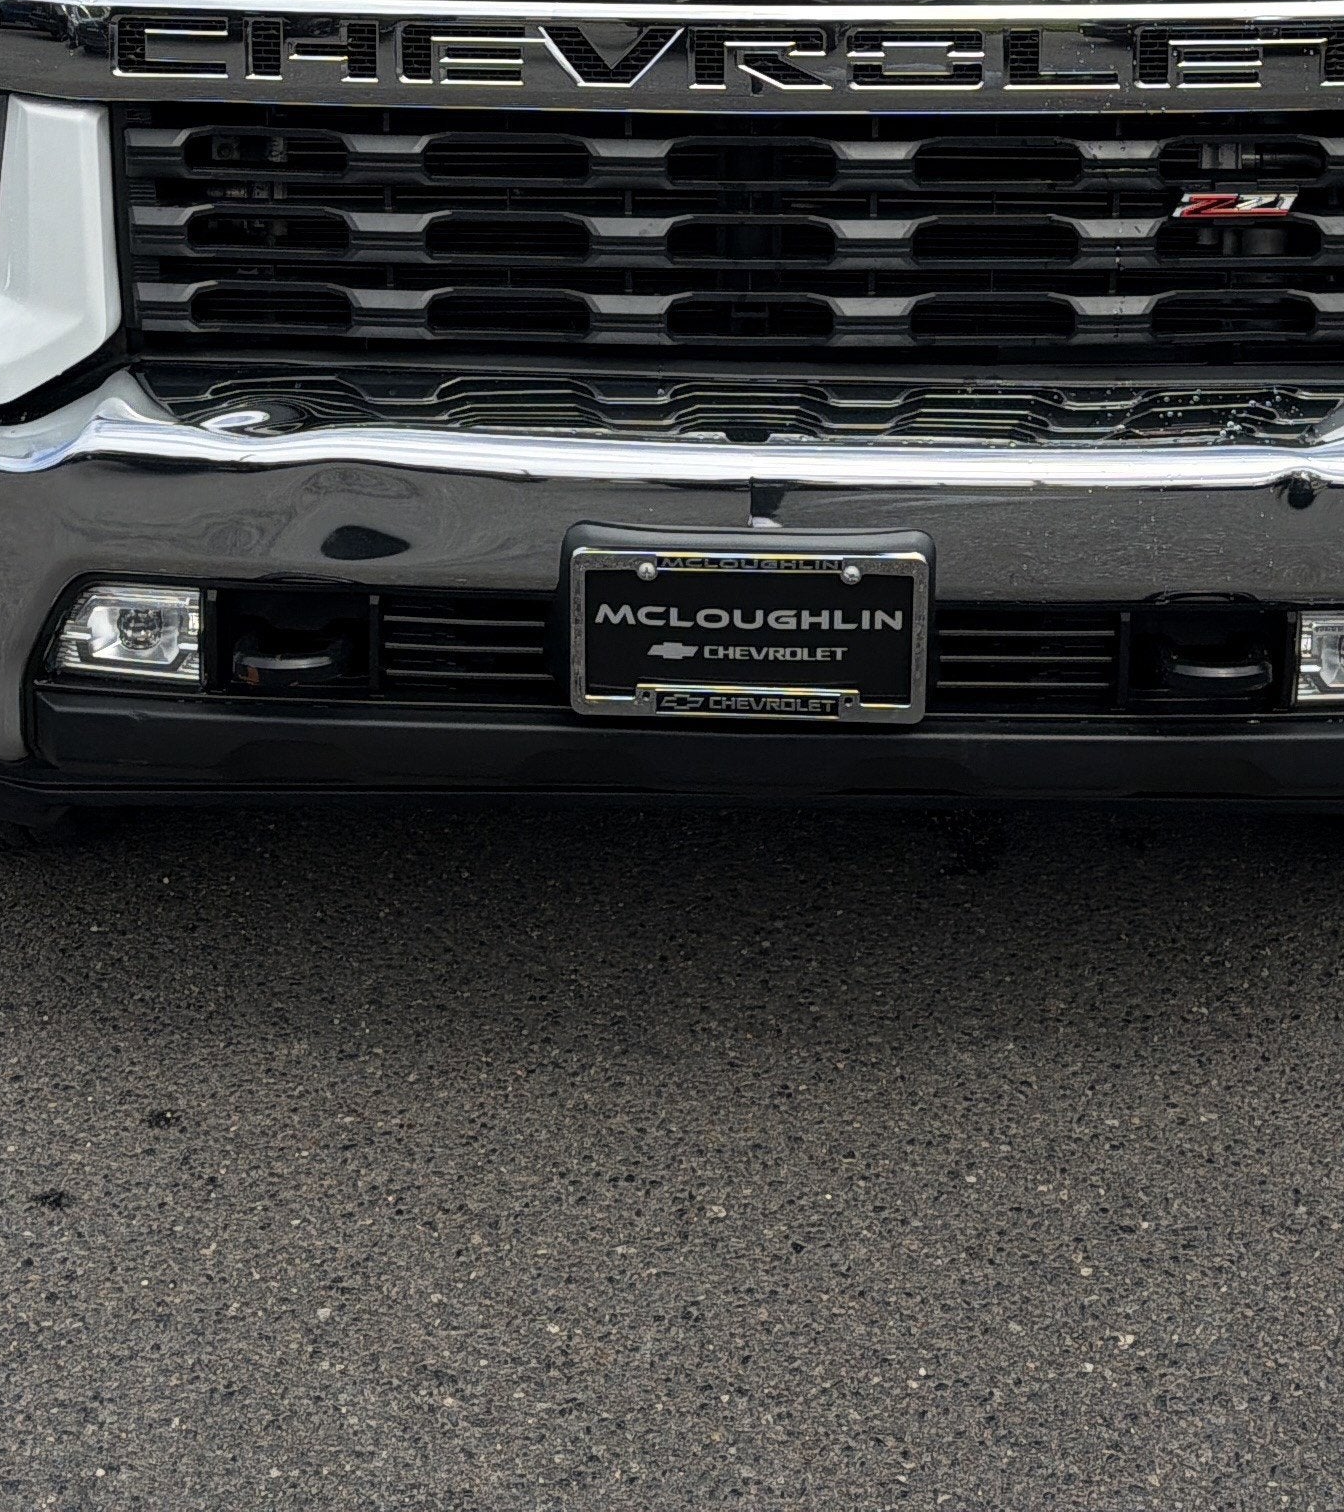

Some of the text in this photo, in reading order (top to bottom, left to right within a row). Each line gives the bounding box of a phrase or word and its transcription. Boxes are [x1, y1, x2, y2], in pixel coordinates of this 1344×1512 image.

[1173, 192, 1298, 218] Z71
[660, 556, 840, 571] MCLOUGHLIN
[595, 603, 903, 631] MCLOUGHLIN
[703, 645, 849, 662] CHEVROLET
[709, 695, 837, 713] CHEVROLET
